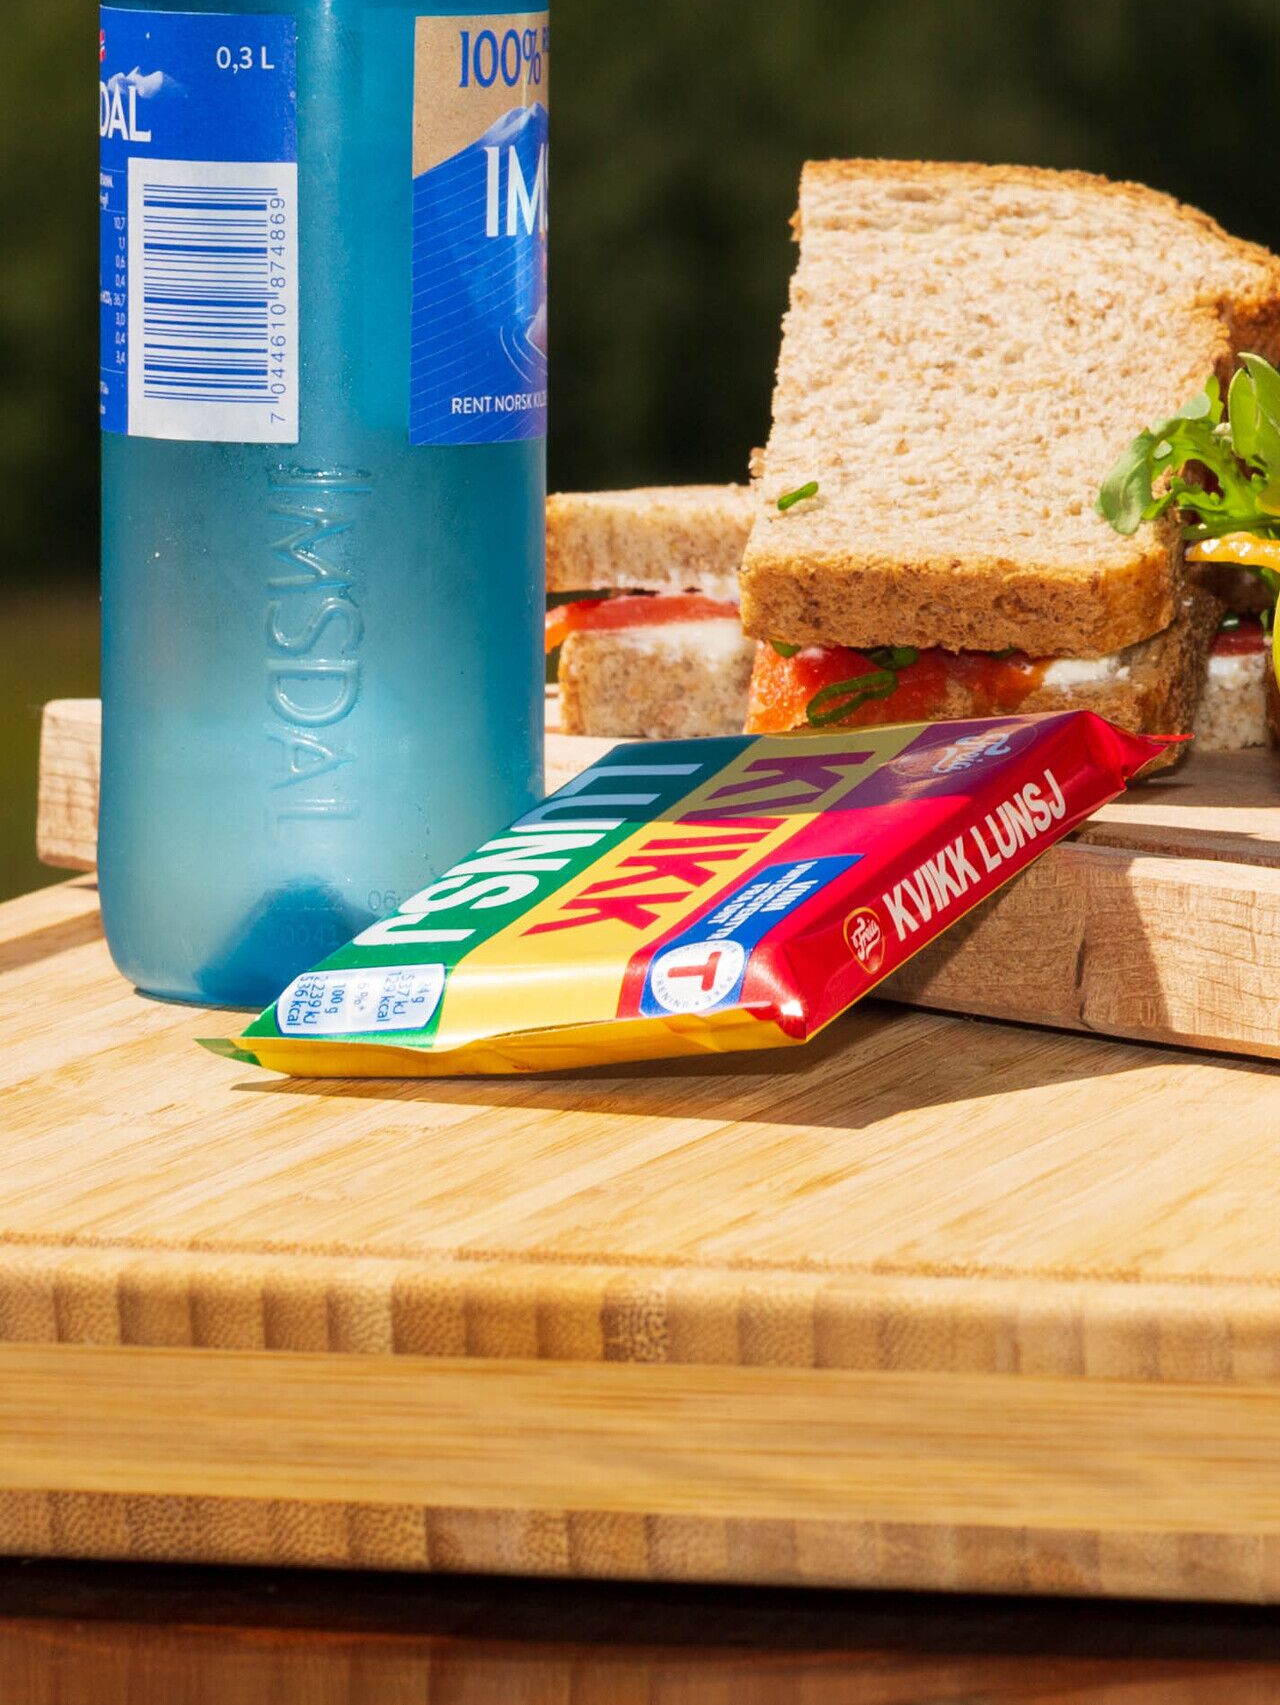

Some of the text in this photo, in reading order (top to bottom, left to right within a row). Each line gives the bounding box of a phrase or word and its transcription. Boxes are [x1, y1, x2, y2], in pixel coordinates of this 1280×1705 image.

[215, 46, 275, 74] 0,3 L
[458, 30, 542, 89] 100%
[451, 393, 532, 414] RENT NORSK
[265, 465, 373, 825] IMSDAL
[352, 763, 704, 948] LUNSJ
[517, 751, 877, 938] KVIKK
[882, 835, 981, 942] KVIKK
[970, 769, 1067, 874] LUNSJ
[851, 917, 881, 962] Freia
